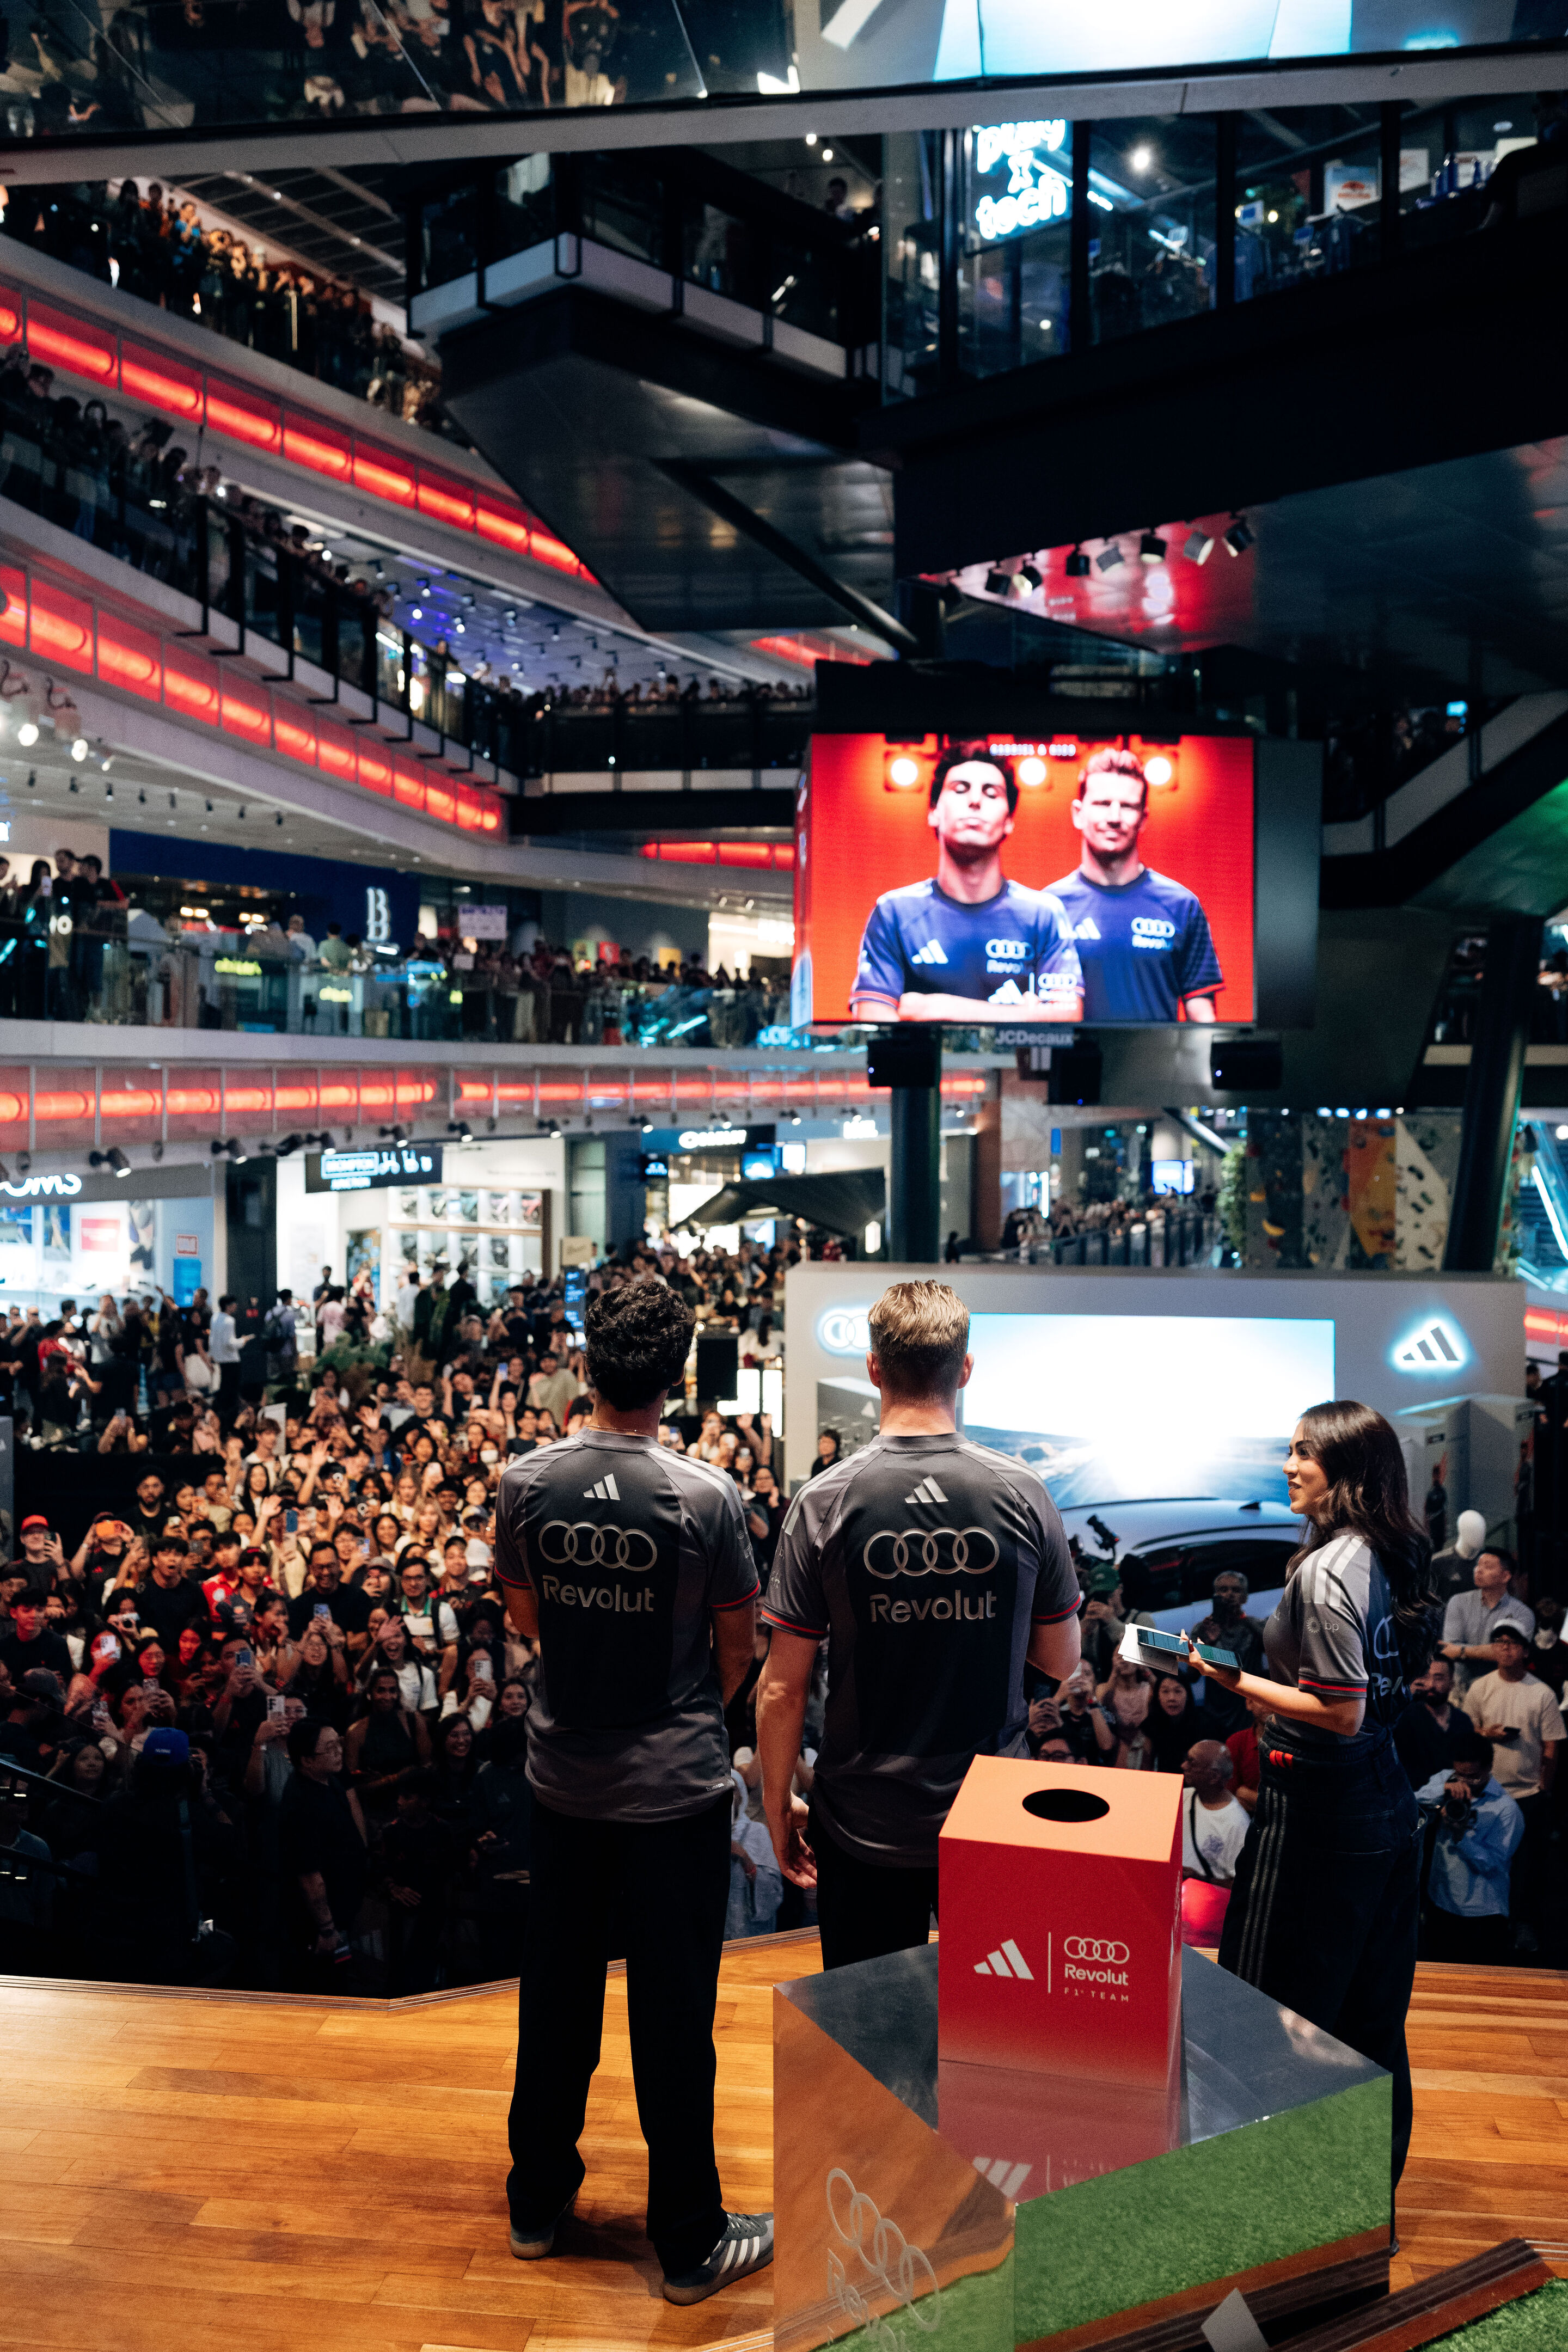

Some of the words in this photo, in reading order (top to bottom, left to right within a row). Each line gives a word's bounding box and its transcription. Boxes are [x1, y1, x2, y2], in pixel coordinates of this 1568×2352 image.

[995, 1030, 1073, 1045] JCDecaux
[542, 1575, 654, 1612] Revolut
[869, 1589, 997, 1624] Revolut
[1325, 1620, 1339, 1633] bp
[1065, 1963, 1129, 1986] Revolut
[1091, 1990, 1129, 2002] TEAM
